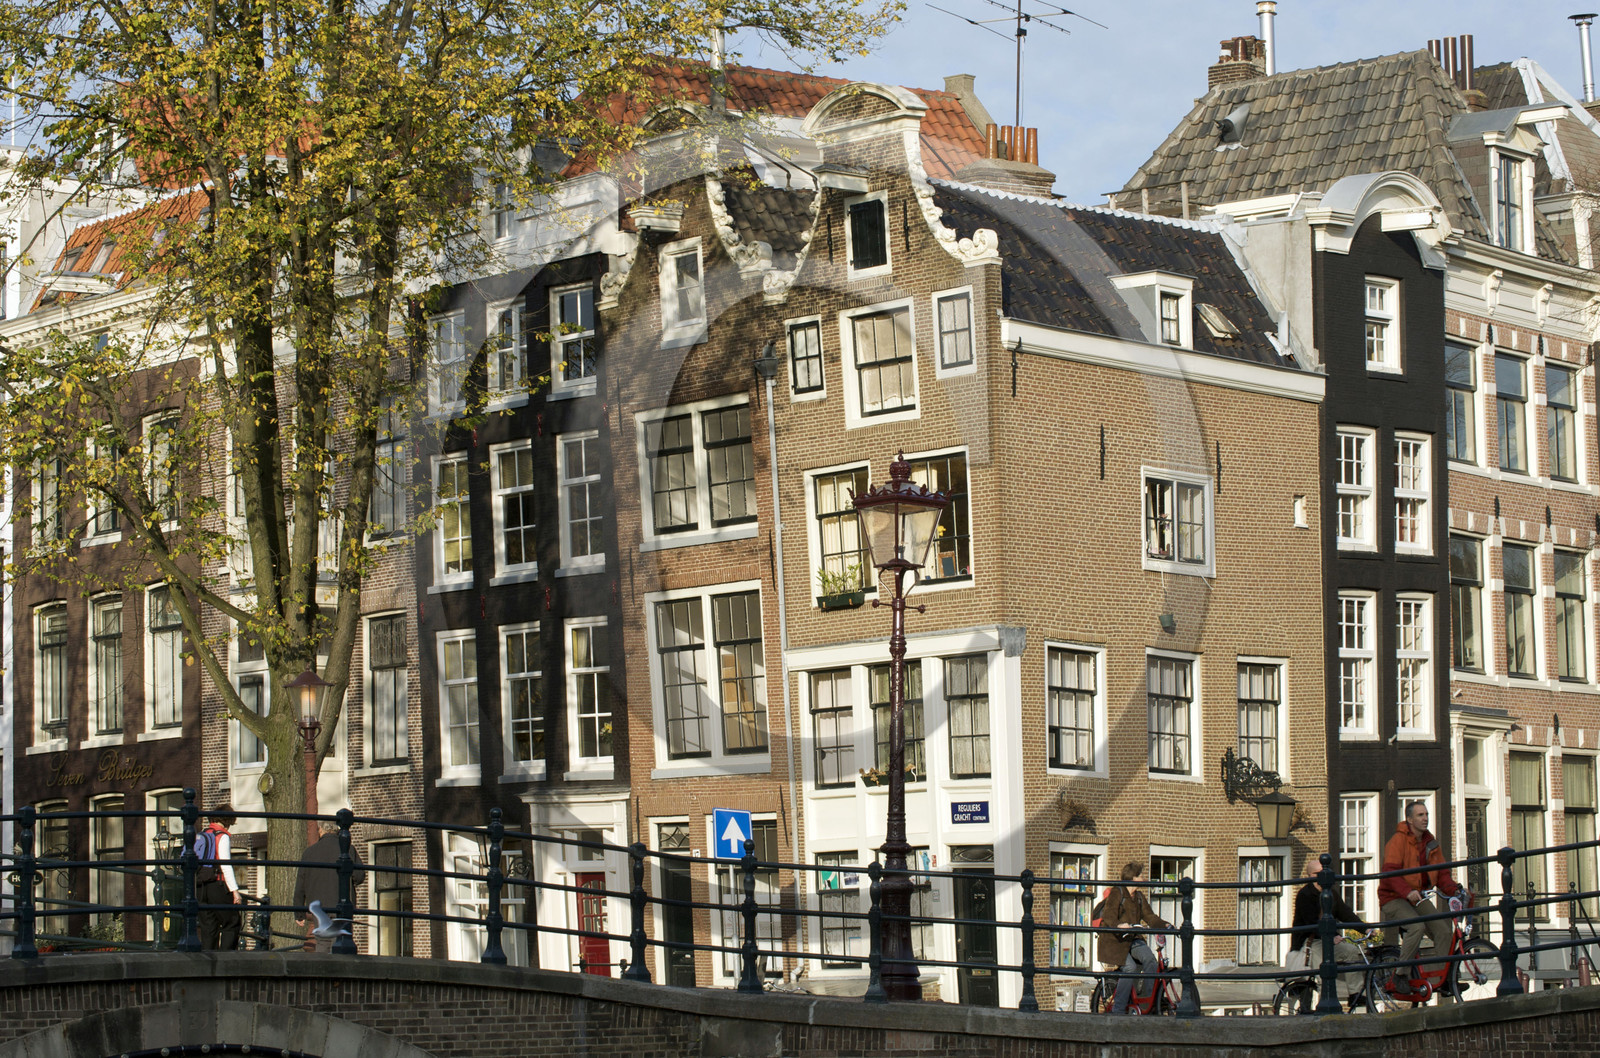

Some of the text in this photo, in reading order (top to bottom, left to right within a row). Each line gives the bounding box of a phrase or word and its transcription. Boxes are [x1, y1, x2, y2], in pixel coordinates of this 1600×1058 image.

[46, 749, 153, 789] Seven Bridges
[958, 804, 981, 812] REGULIERS
